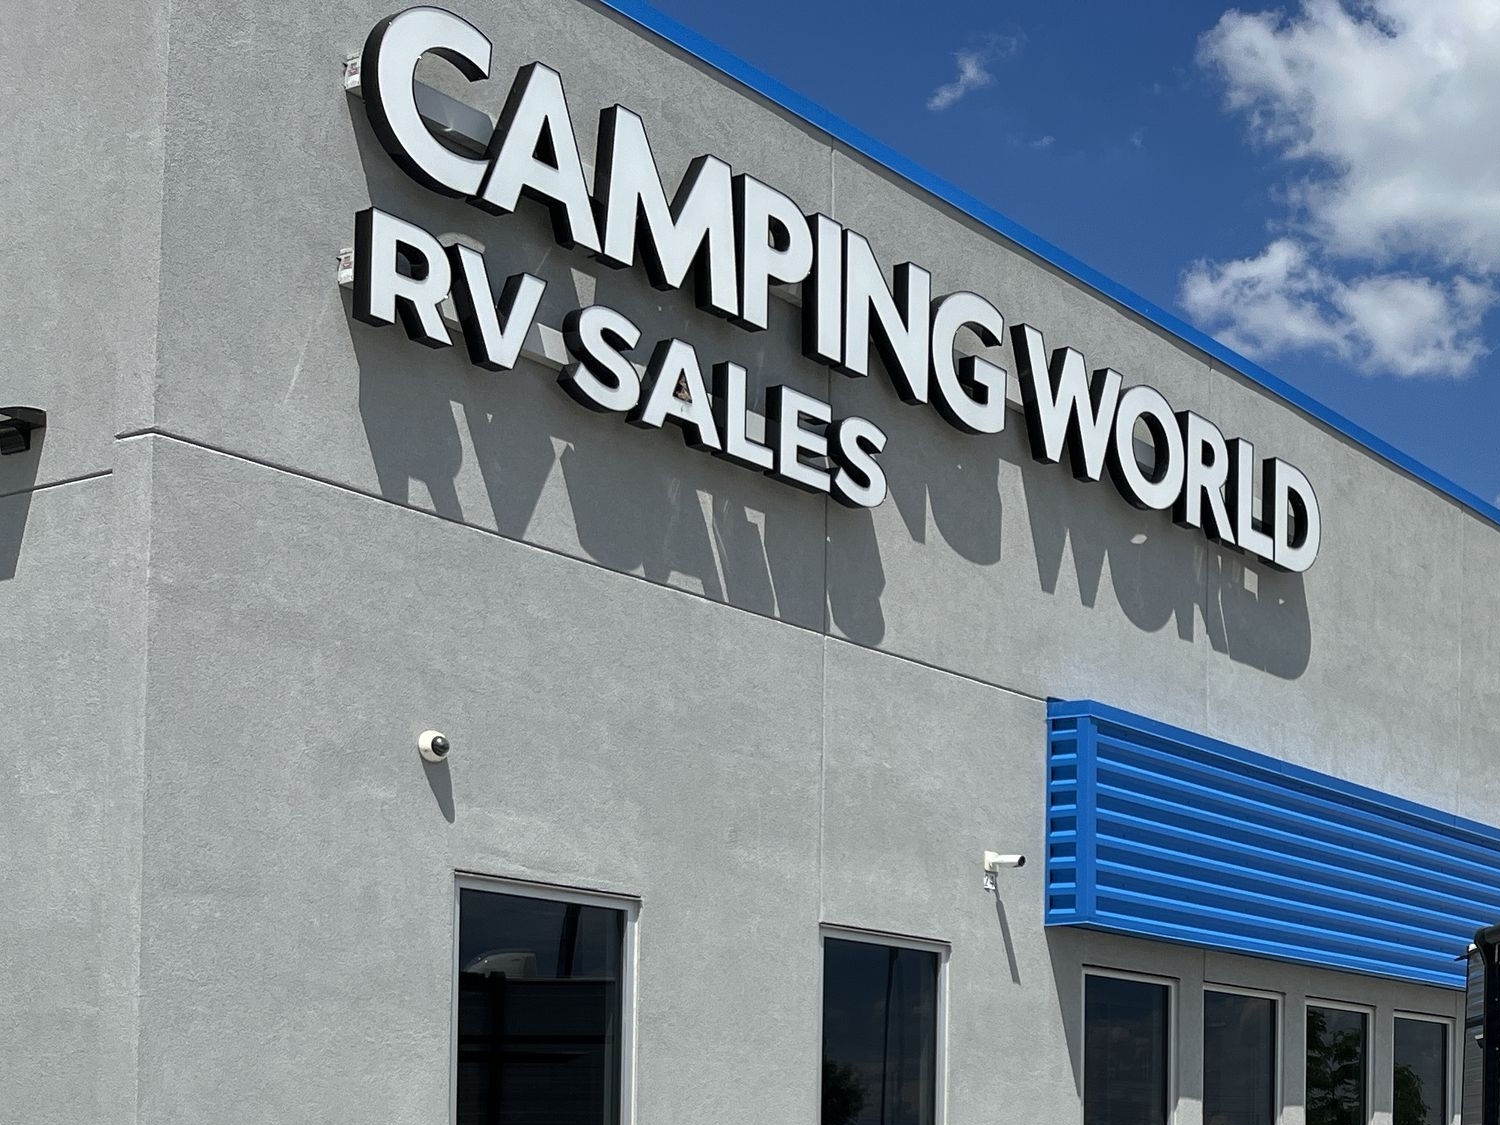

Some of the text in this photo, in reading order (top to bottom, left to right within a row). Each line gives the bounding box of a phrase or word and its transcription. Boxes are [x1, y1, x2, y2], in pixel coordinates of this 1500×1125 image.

[353, 207, 888, 510] RV SALES
[364, 6, 1321, 574] CAMPING WORLD
